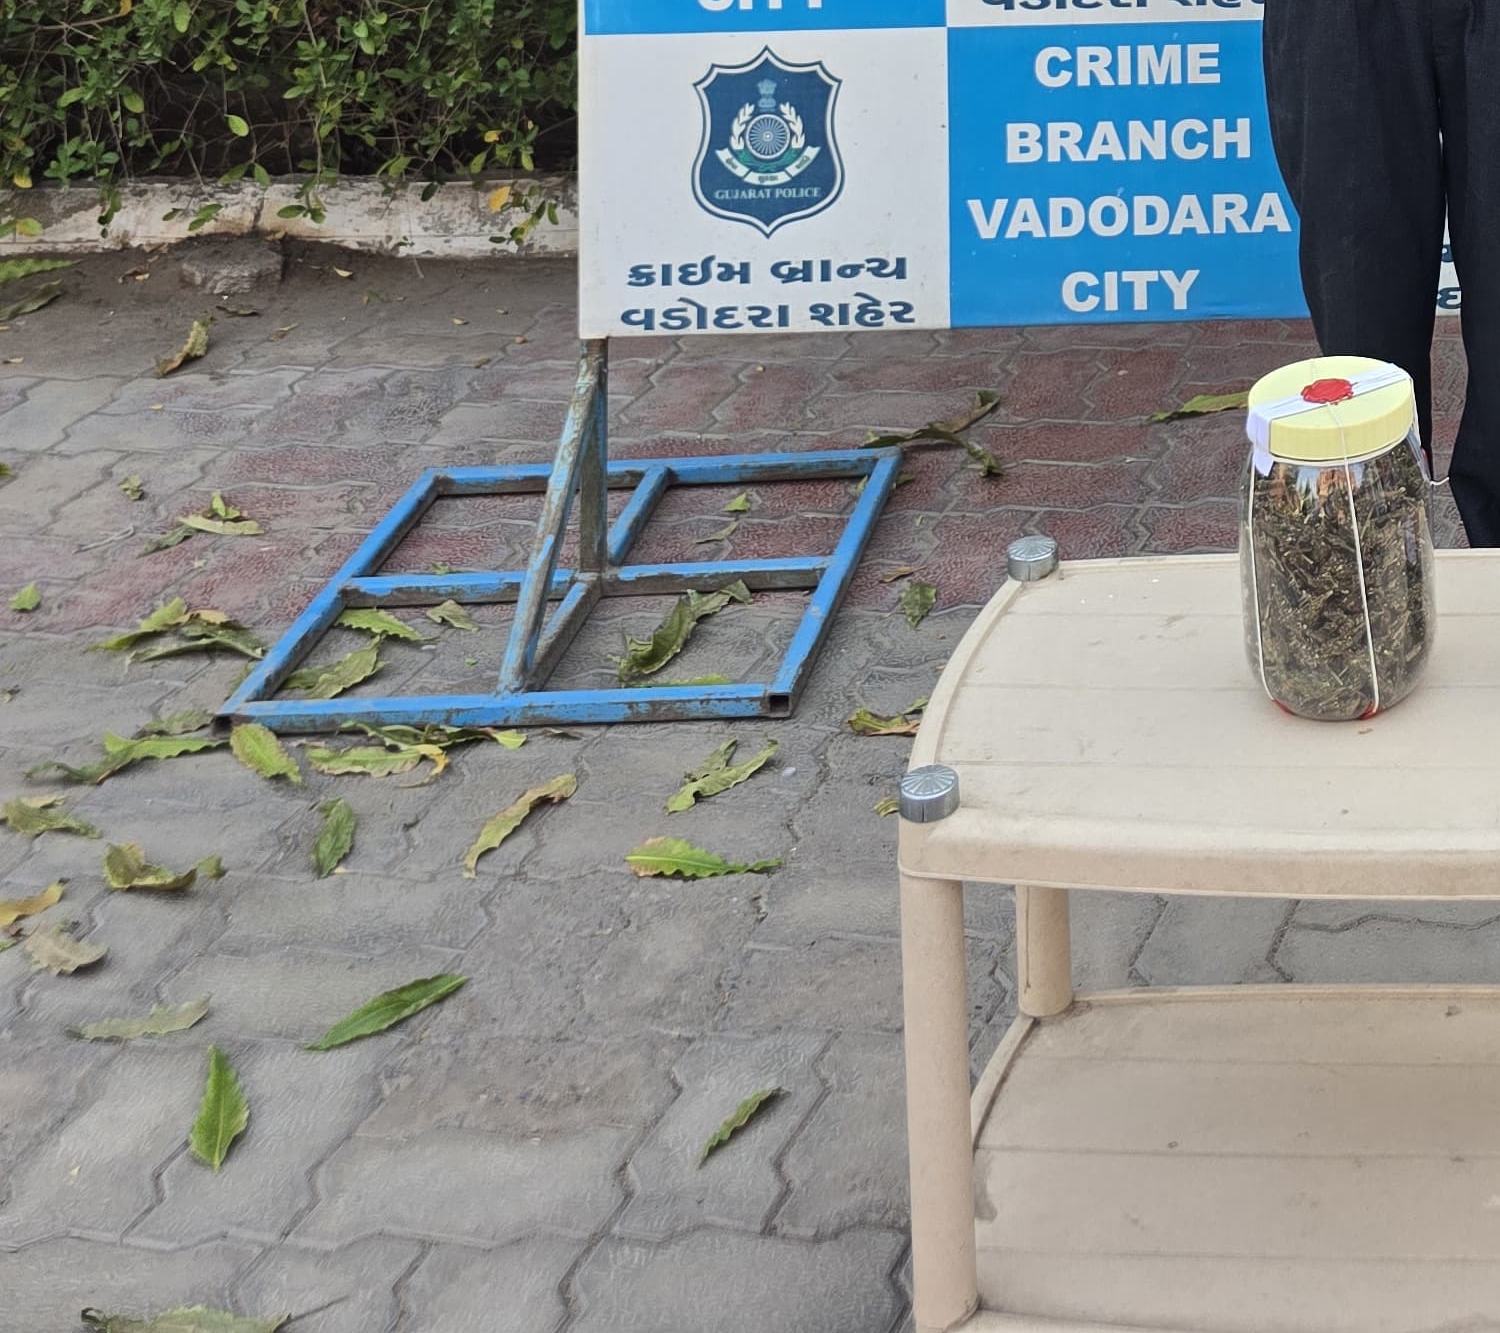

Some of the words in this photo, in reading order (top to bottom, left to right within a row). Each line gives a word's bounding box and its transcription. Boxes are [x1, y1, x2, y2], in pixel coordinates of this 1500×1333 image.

[1034, 43, 1221, 88] CRIME
[1006, 117, 1251, 163] BRANCH
[714, 188, 771, 200] GUJARAT
[774, 186, 822, 199] POLICE
[967, 192, 1291, 239] VADODARA
[627, 254, 751, 287] ક્રાઈમ
[770, 257, 907, 285] બ્રાન્ચ
[1061, 269, 1200, 313] CITY
[620, 297, 789, 331] વડોદરા
[808, 291, 914, 328] શહેર
